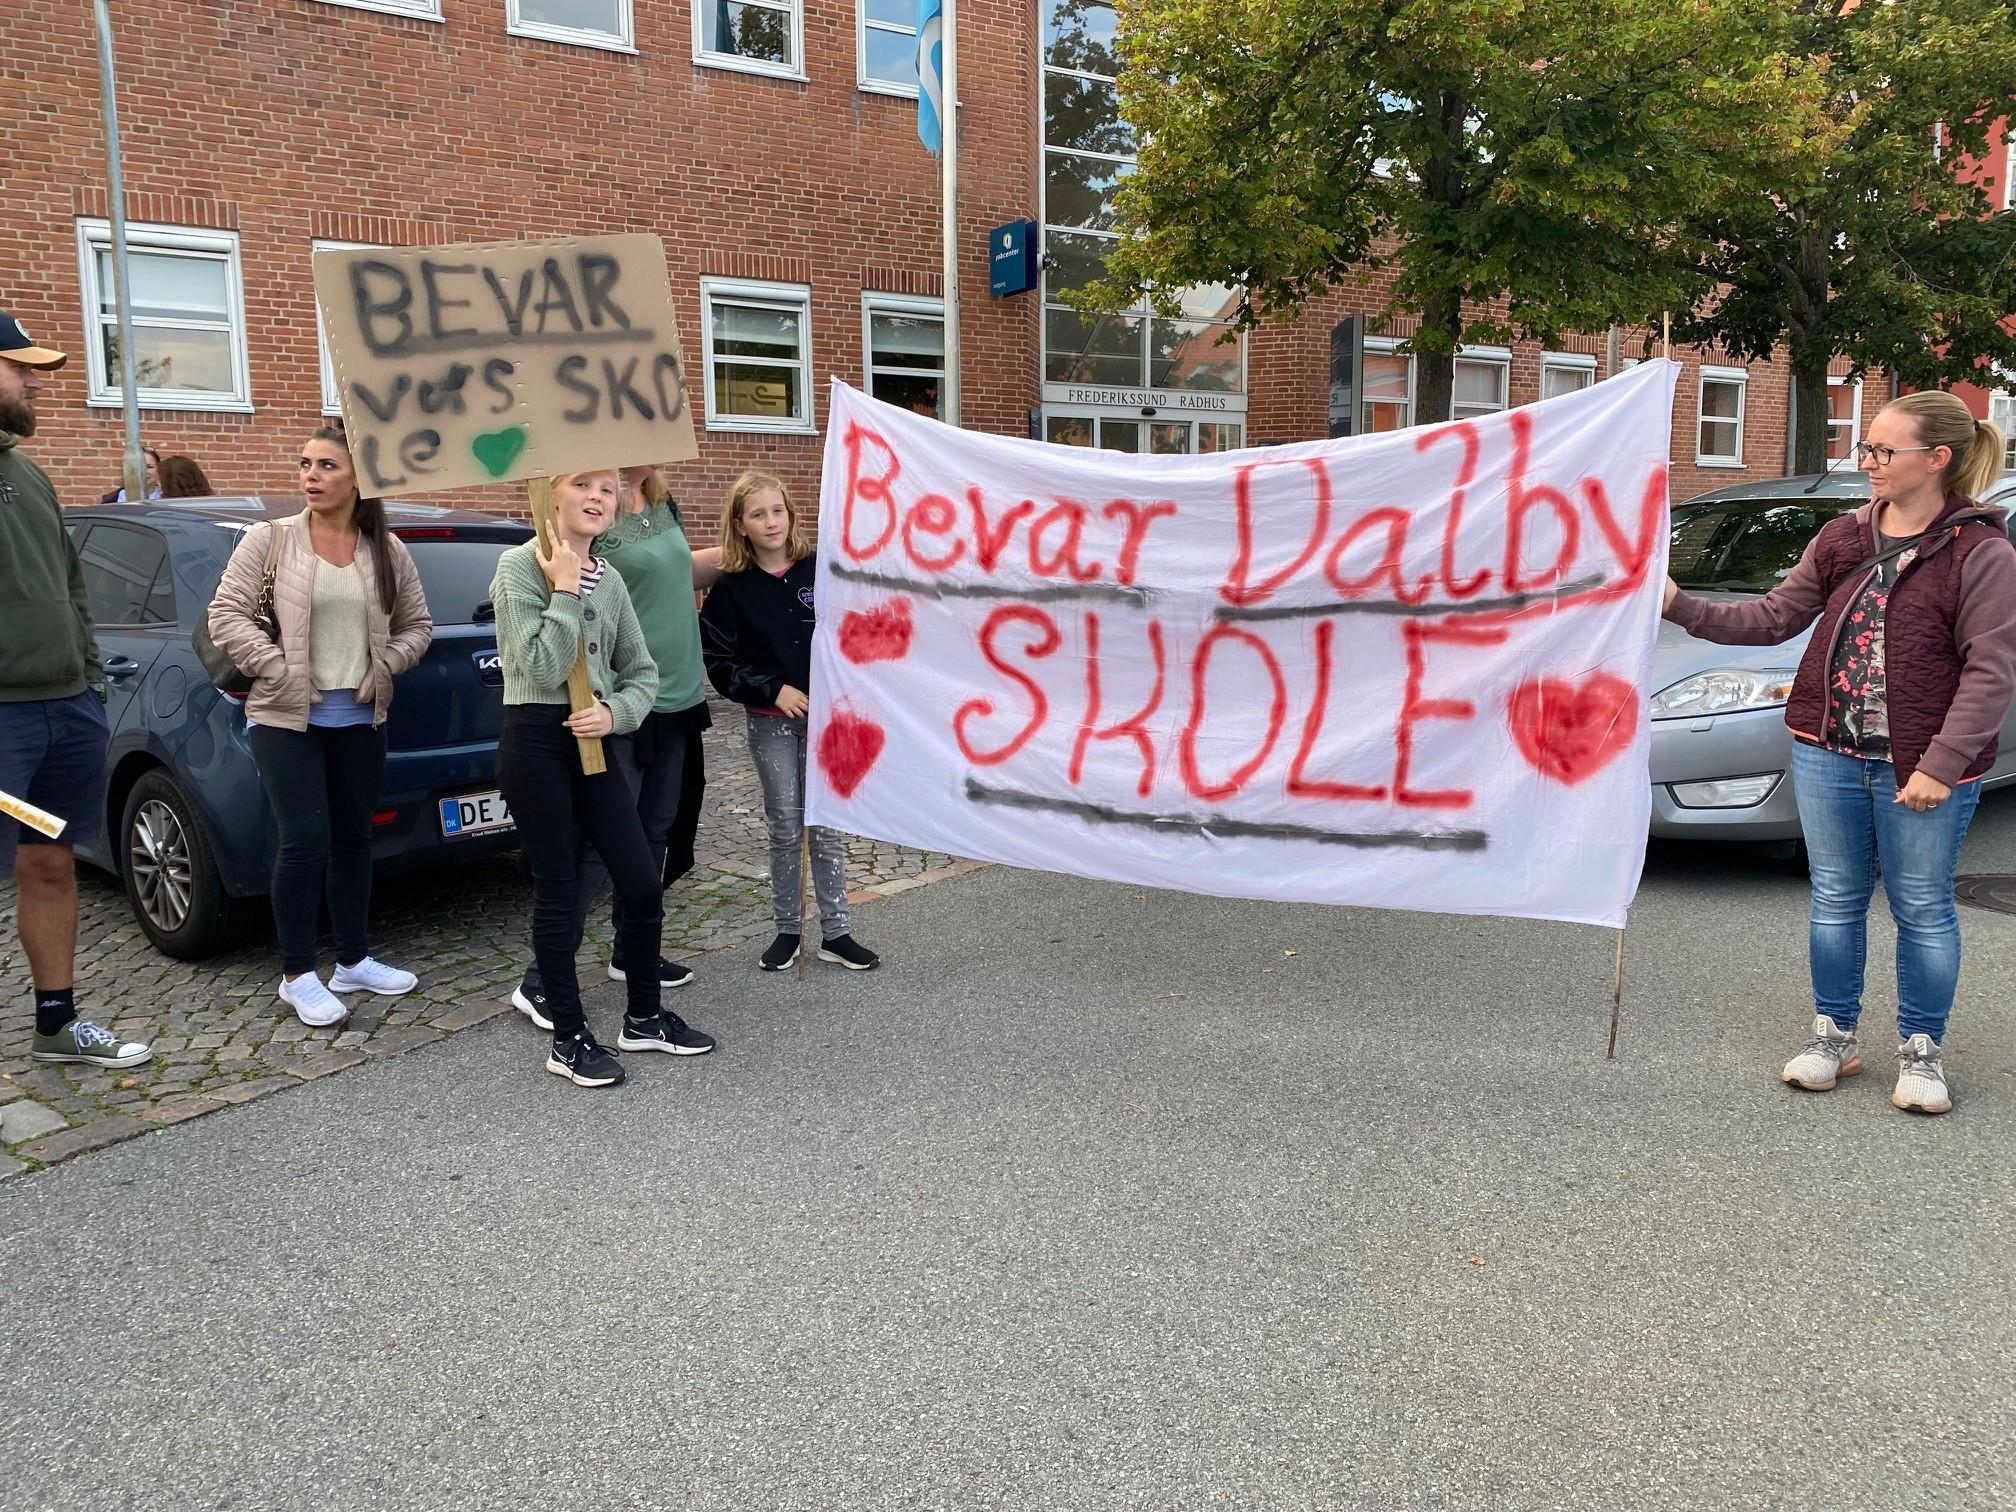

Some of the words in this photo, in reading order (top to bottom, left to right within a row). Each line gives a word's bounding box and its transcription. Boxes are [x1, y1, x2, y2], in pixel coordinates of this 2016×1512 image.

[349, 253, 631, 357] BEVAR
[555, 353, 686, 422] SKO
[1068, 388, 1167, 407] FREDERIKSSUND
[841, 418, 1179, 586] Bevar
[1219, 409, 1668, 628] Dalby
[479, 656, 503, 669] KI
[952, 604, 1509, 809] SKOLE
[446, 819, 456, 828] DK
